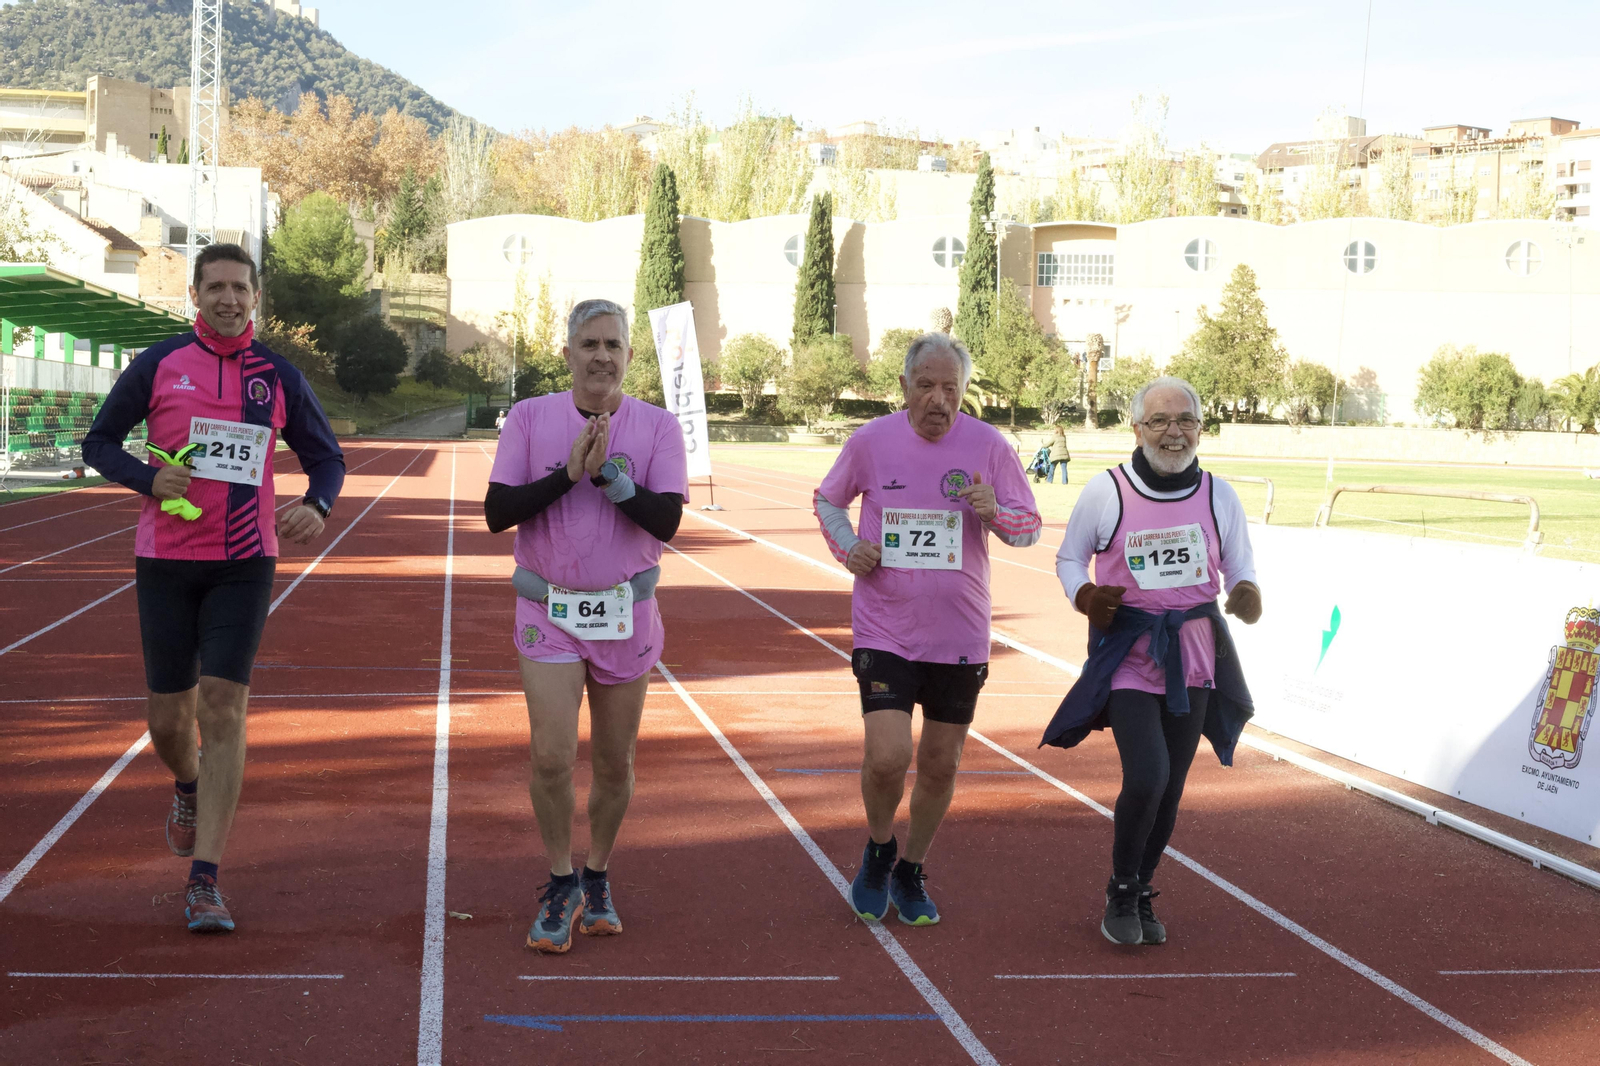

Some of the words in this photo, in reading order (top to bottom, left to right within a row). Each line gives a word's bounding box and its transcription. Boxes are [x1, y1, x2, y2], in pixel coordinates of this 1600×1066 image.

[193, 421, 210, 435] XXV
[210, 423, 227, 431] CARRERA
[238, 427, 254, 435] PUENTES
[209, 441, 251, 461] 215
[885, 511, 900, 525] XXV
[909, 530, 936, 546] 72
[1127, 534, 1143, 548] XXV
[1143, 532, 1161, 540] CARRERA
[1172, 530, 1187, 538] PUENTES
[1148, 547, 1191, 566] 125
[1159, 569, 1183, 577] SERRANO
[578, 600, 606, 617] 64
[1522, 764, 1540, 777] EXCMO.
[1540, 771, 1580, 790] AYUNTAMIENTO
[1537, 781, 1545, 790] DE
[1544, 784, 1558, 794] JAÉN
